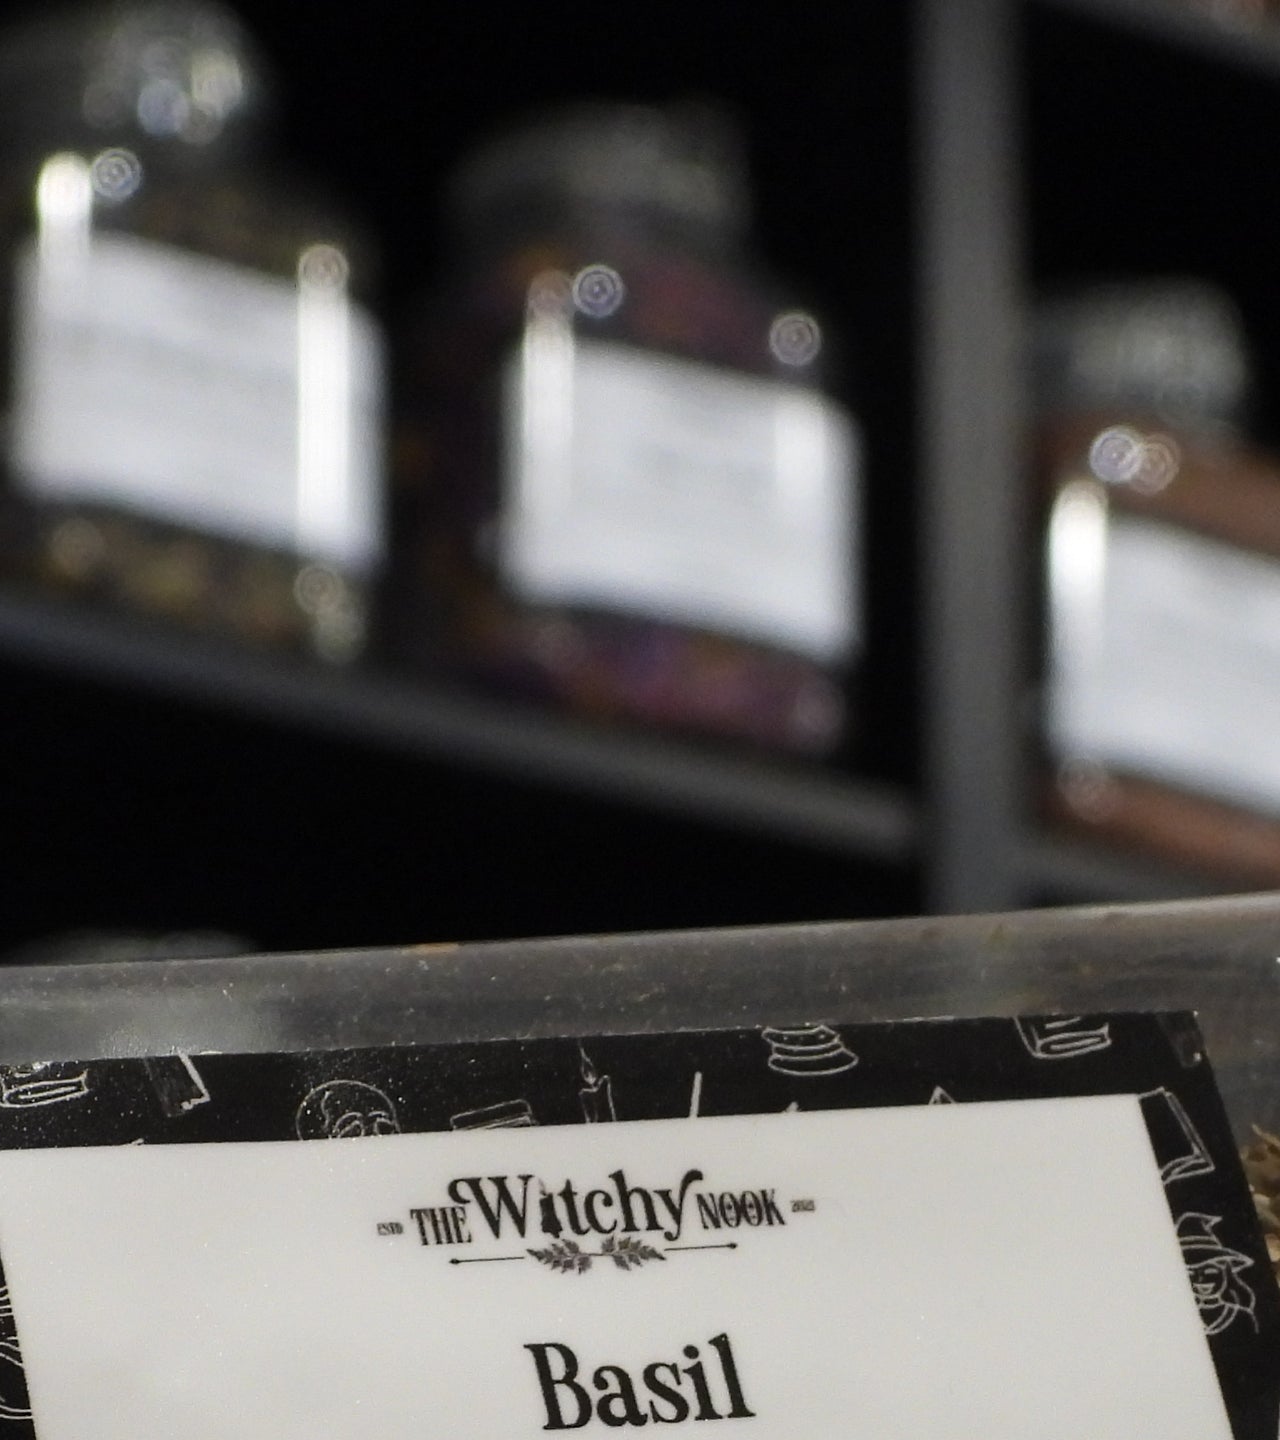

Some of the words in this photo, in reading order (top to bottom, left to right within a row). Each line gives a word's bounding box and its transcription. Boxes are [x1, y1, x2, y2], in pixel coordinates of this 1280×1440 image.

[409, 1206, 473, 1246] THE
[699, 1188, 787, 1230] NOOK
[522, 1332, 757, 1431] Basil
